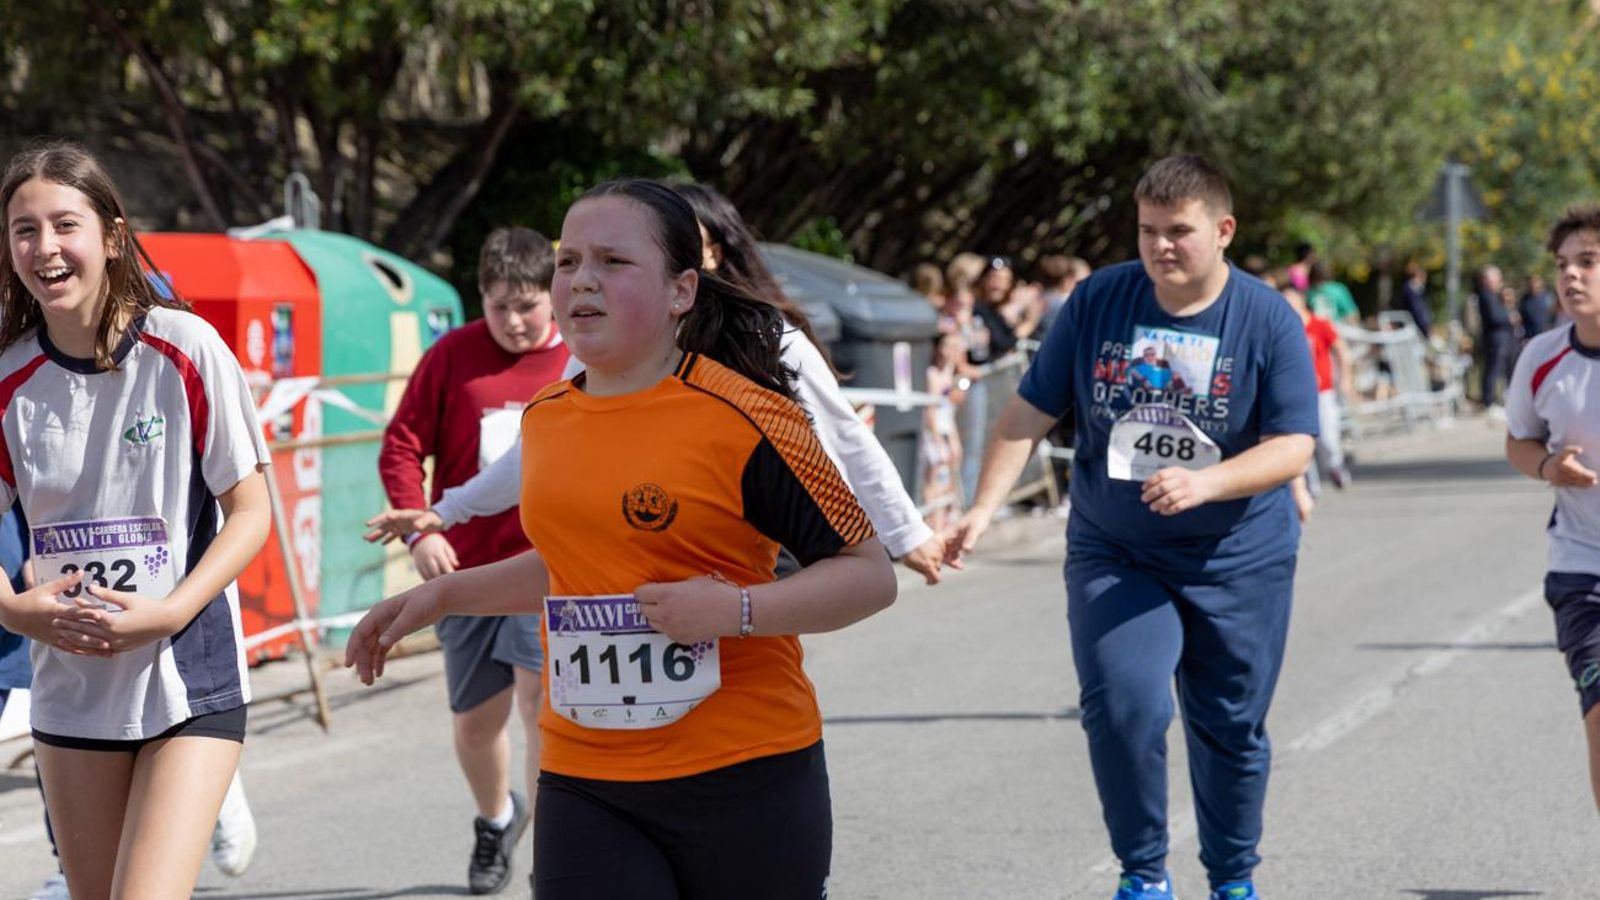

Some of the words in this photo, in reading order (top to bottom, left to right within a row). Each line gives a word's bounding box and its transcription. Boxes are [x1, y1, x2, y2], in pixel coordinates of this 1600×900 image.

[1093, 382, 1125, 404] OF
[1131, 387, 1230, 419] OTHERS
[1133, 431, 1196, 461] 468
[54, 527, 94, 549] XXXVI
[95, 523, 128, 536] CARRERA
[101, 534, 112, 546] LA
[118, 530, 153, 545] GLORIA
[60, 558, 138, 598] 332
[573, 603, 624, 629] XXXVI
[633, 614, 648, 626] LA
[570, 642, 696, 684] 1116
